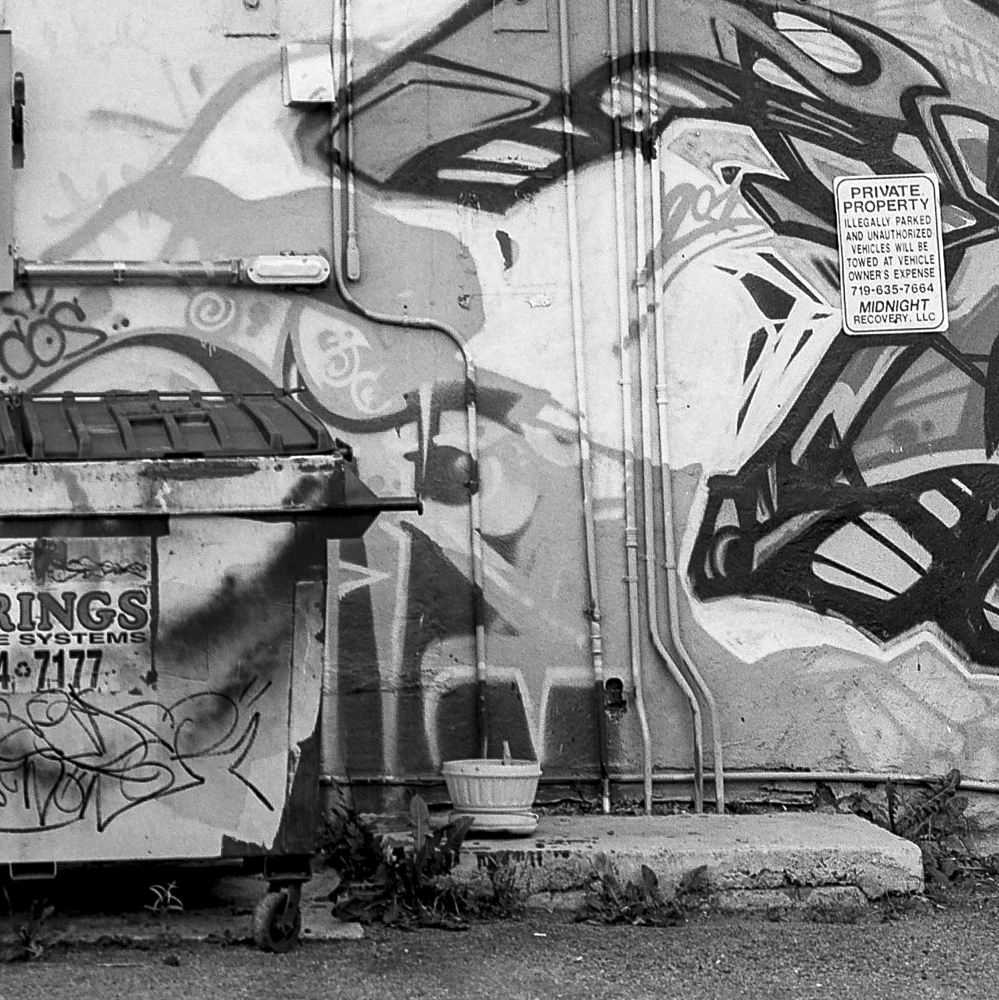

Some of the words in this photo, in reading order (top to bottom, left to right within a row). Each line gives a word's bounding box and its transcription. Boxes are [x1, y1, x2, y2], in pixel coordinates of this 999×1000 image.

[851, 185, 920, 199] PRIVATE
[844, 198, 929, 213] PROPERTY
[844, 217, 890, 228] ILLEGALLY
[896, 215, 931, 226] PARKED
[846, 231, 863, 241] AND
[867, 229, 932, 240] UNAUTHORIZED
[851, 243, 891, 254] VEHICLES
[895, 242, 914, 252] WILL
[918, 242, 928, 251] BE
[847, 257, 878, 267] TOWED
[883, 256, 893, 266] AT
[898, 255, 935, 265] VEHICLE
[894, 268, 935, 279] EXPENSE
[859, 299, 930, 313] MIDNIGHT
[917, 313, 936, 322] LLC
[19, 632, 147, 645] SYSTEMS
[33, 648, 103, 689] 7177
